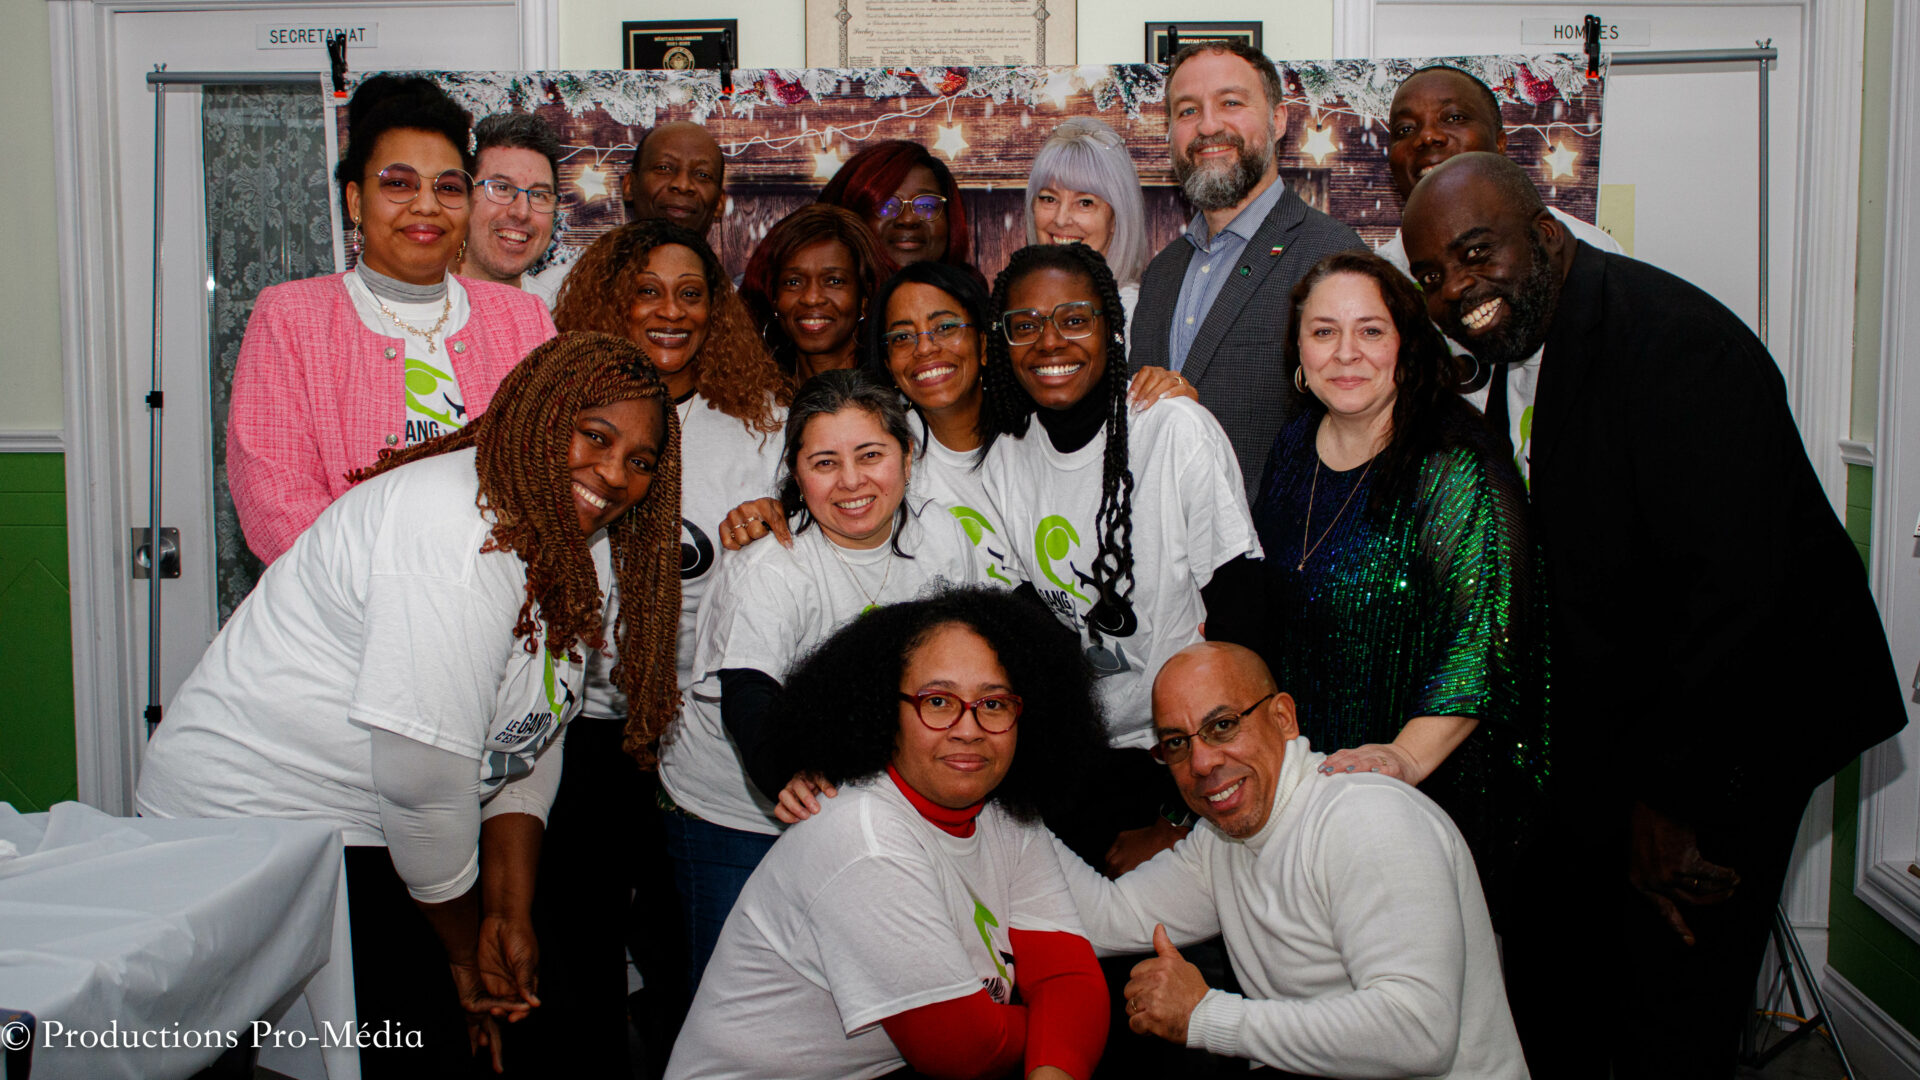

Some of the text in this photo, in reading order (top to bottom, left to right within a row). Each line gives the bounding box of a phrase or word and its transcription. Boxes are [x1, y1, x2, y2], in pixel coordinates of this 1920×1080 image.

[1553, 24, 1620, 40] HOMES
[405, 420, 440, 442] ANG
[505, 719, 520, 732] LE
